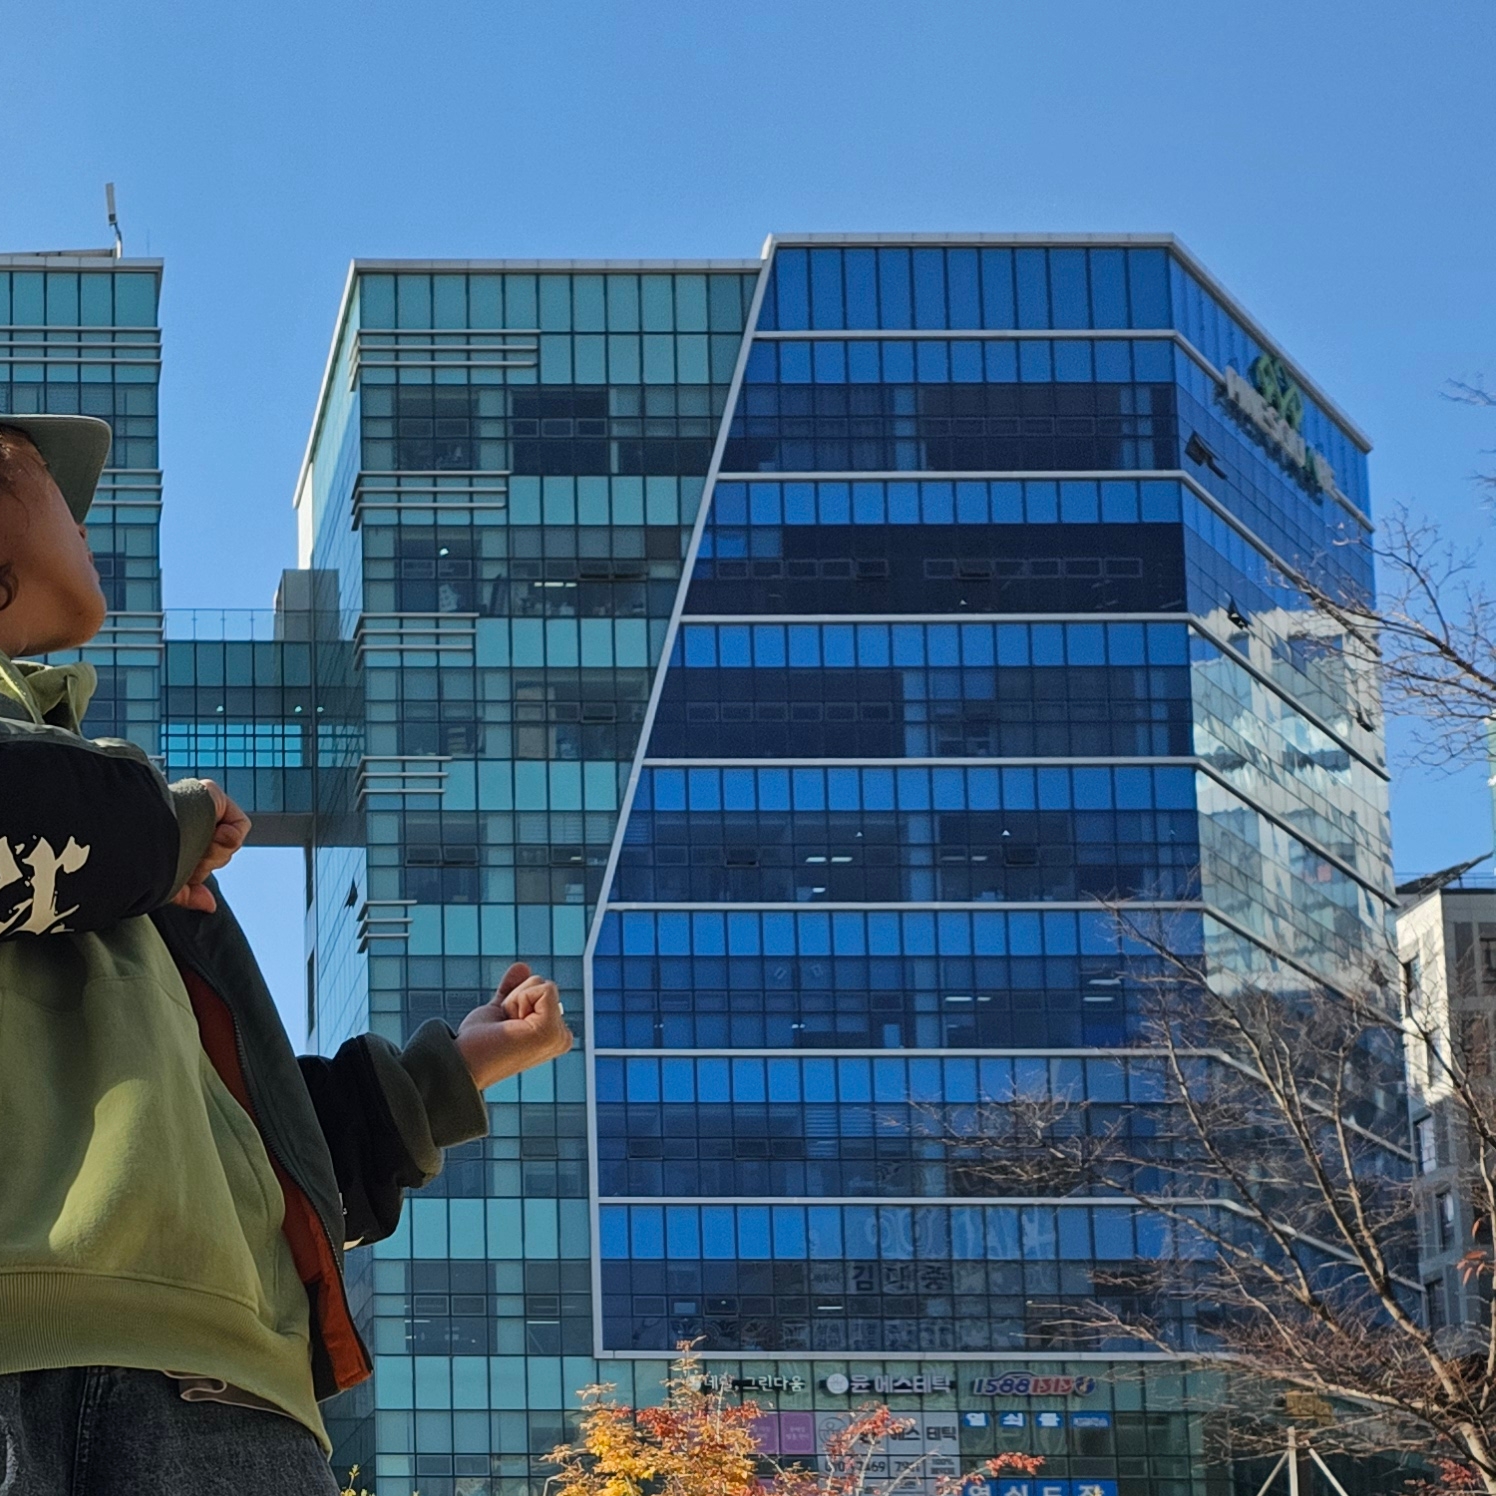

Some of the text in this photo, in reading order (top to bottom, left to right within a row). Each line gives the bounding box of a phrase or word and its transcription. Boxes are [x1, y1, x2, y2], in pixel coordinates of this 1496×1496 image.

[743, 1375, 806, 1392] 그린다움
[850, 1375, 951, 1394] 윤 에스테틱
